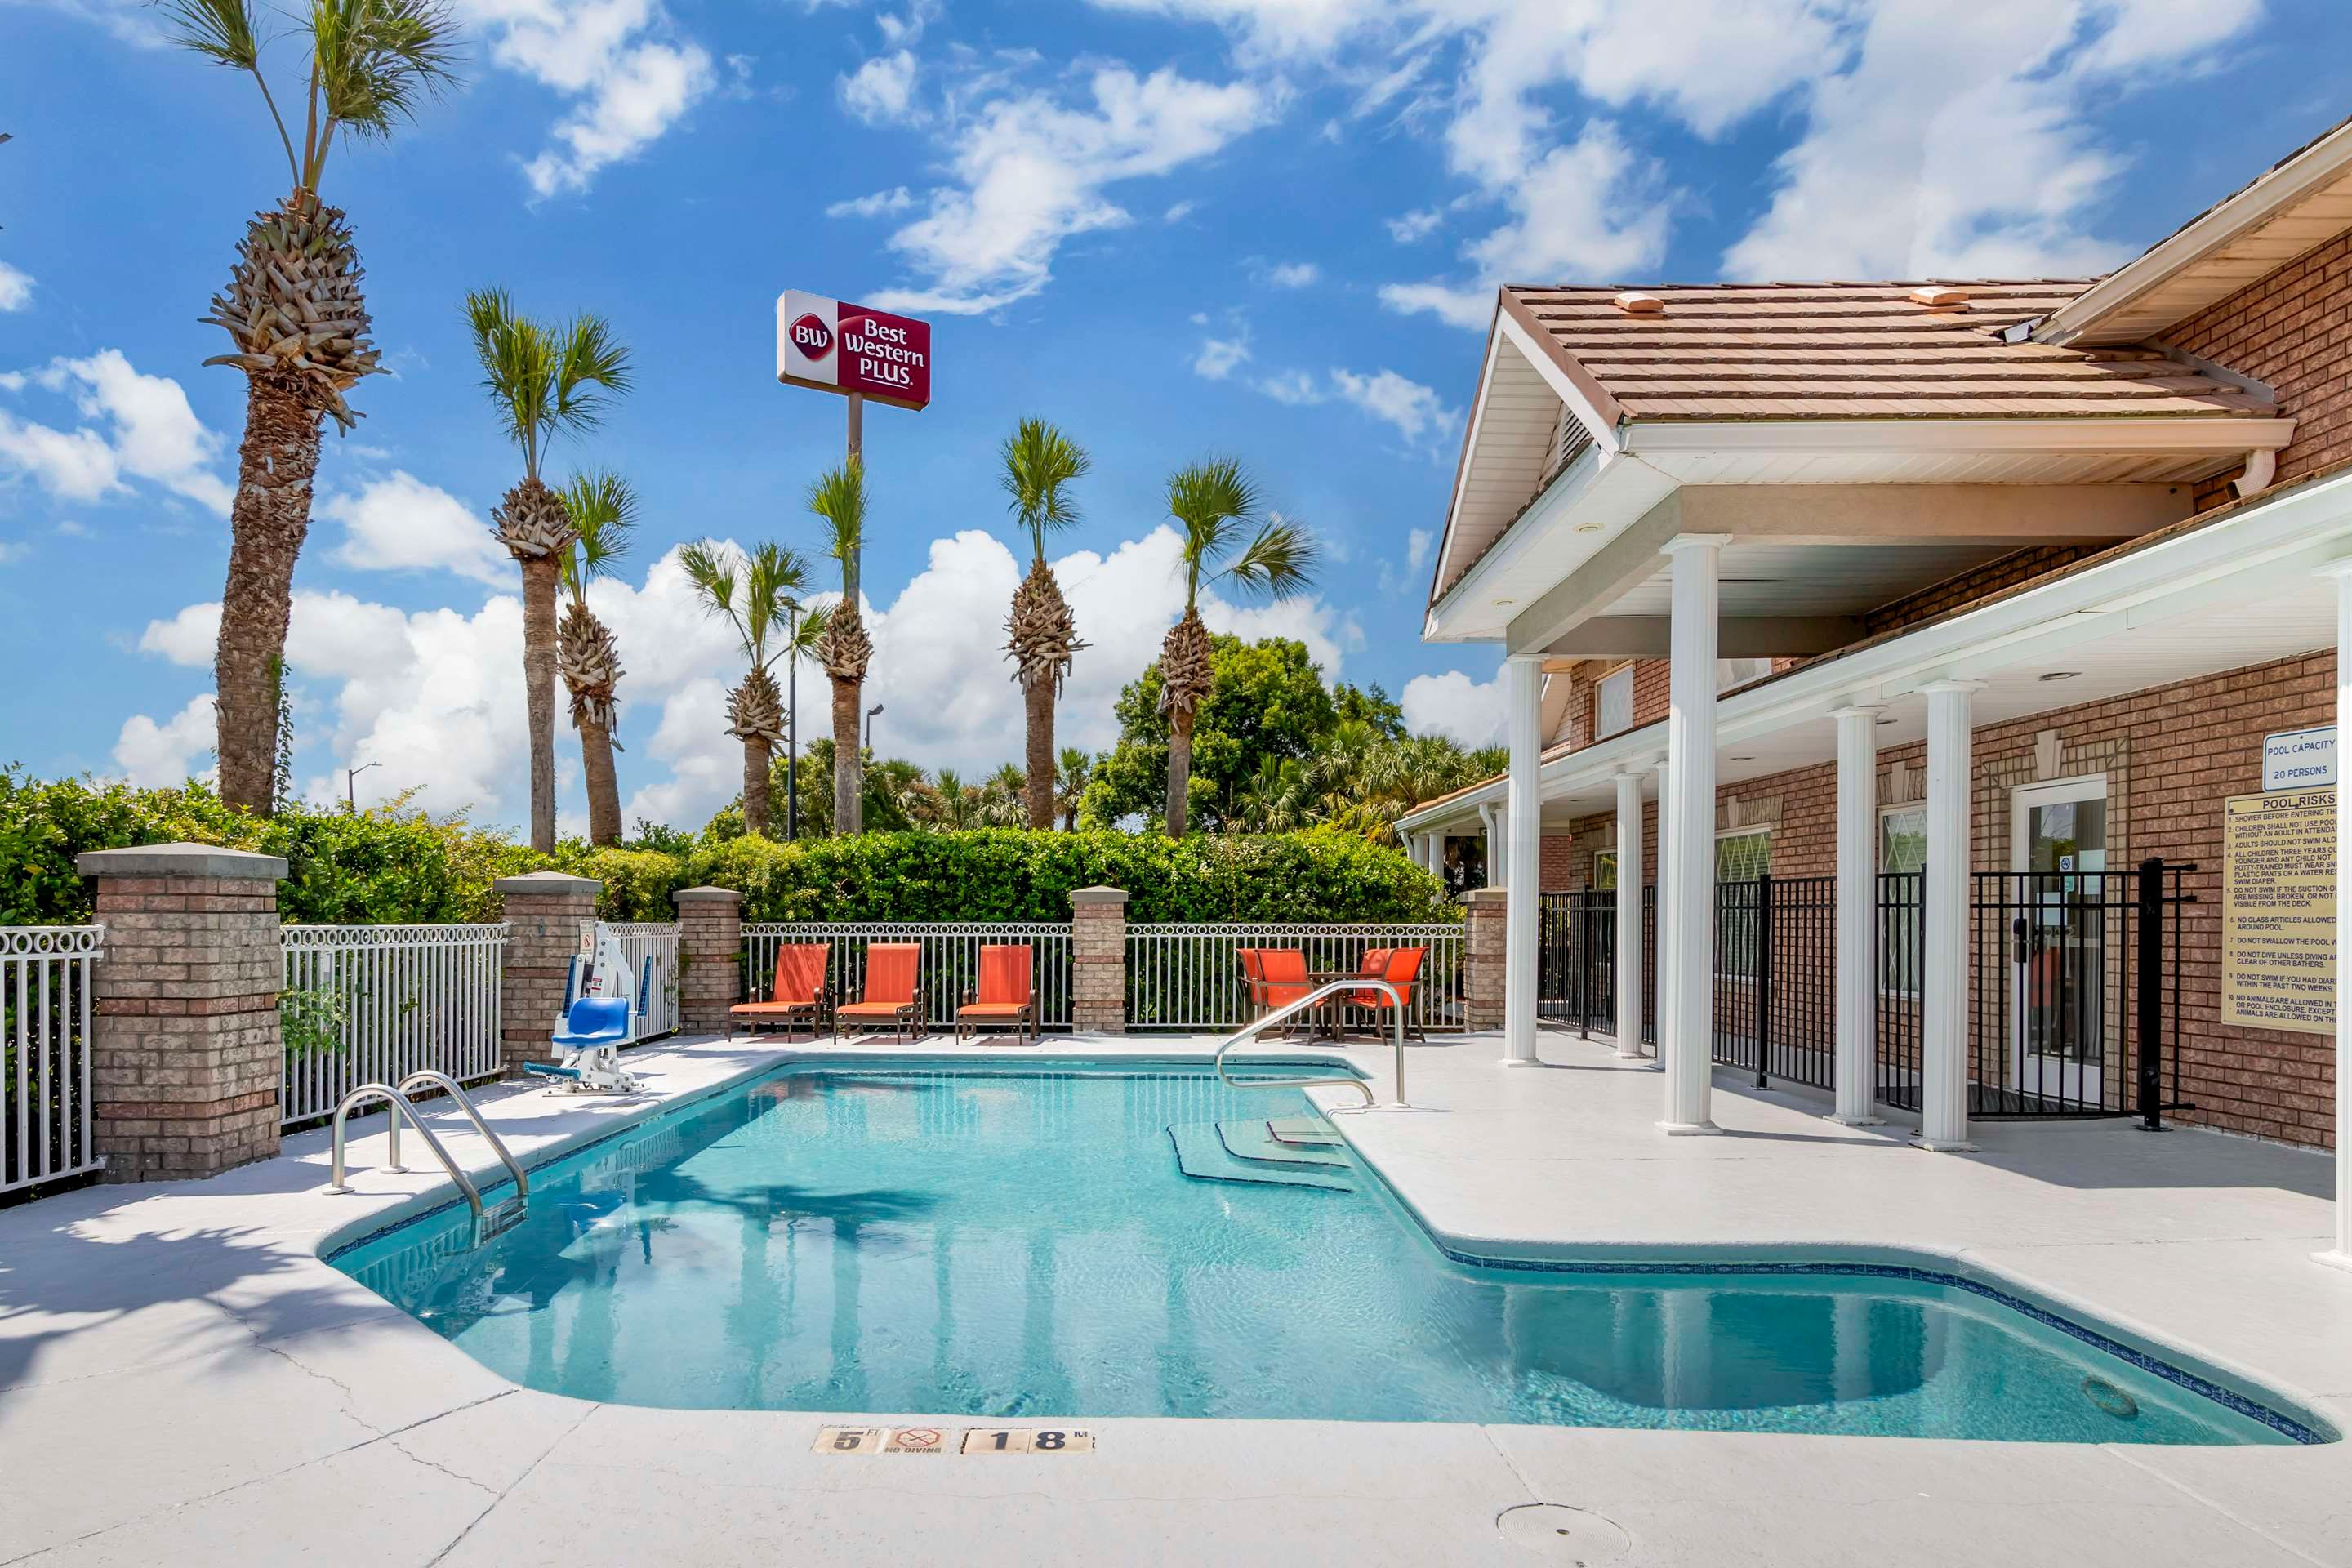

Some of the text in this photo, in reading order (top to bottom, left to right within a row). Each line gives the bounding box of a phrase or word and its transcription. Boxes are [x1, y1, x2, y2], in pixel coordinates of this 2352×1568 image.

[796, 325, 828, 347] BW
[865, 318, 907, 345] Best
[845, 332, 924, 367] Western
[2268, 739, 2336, 756] POOL CAPACITY
[2274, 765, 2328, 780] 20 PERSONS
[2263, 794, 2336, 809] POOL RISKS
[2291, 809, 2324, 817] ENTERING
[2235, 823, 2265, 832] CHILDREN
[2234, 863, 2283, 871] POTTY-TRAINED
[2247, 995, 2274, 1003] ANIMALS
[2236, 1009, 2263, 1017] ANIMALS
[2309, 1007, 2336, 1015] EXCEPT
[833, 1431, 864, 1450] 5
